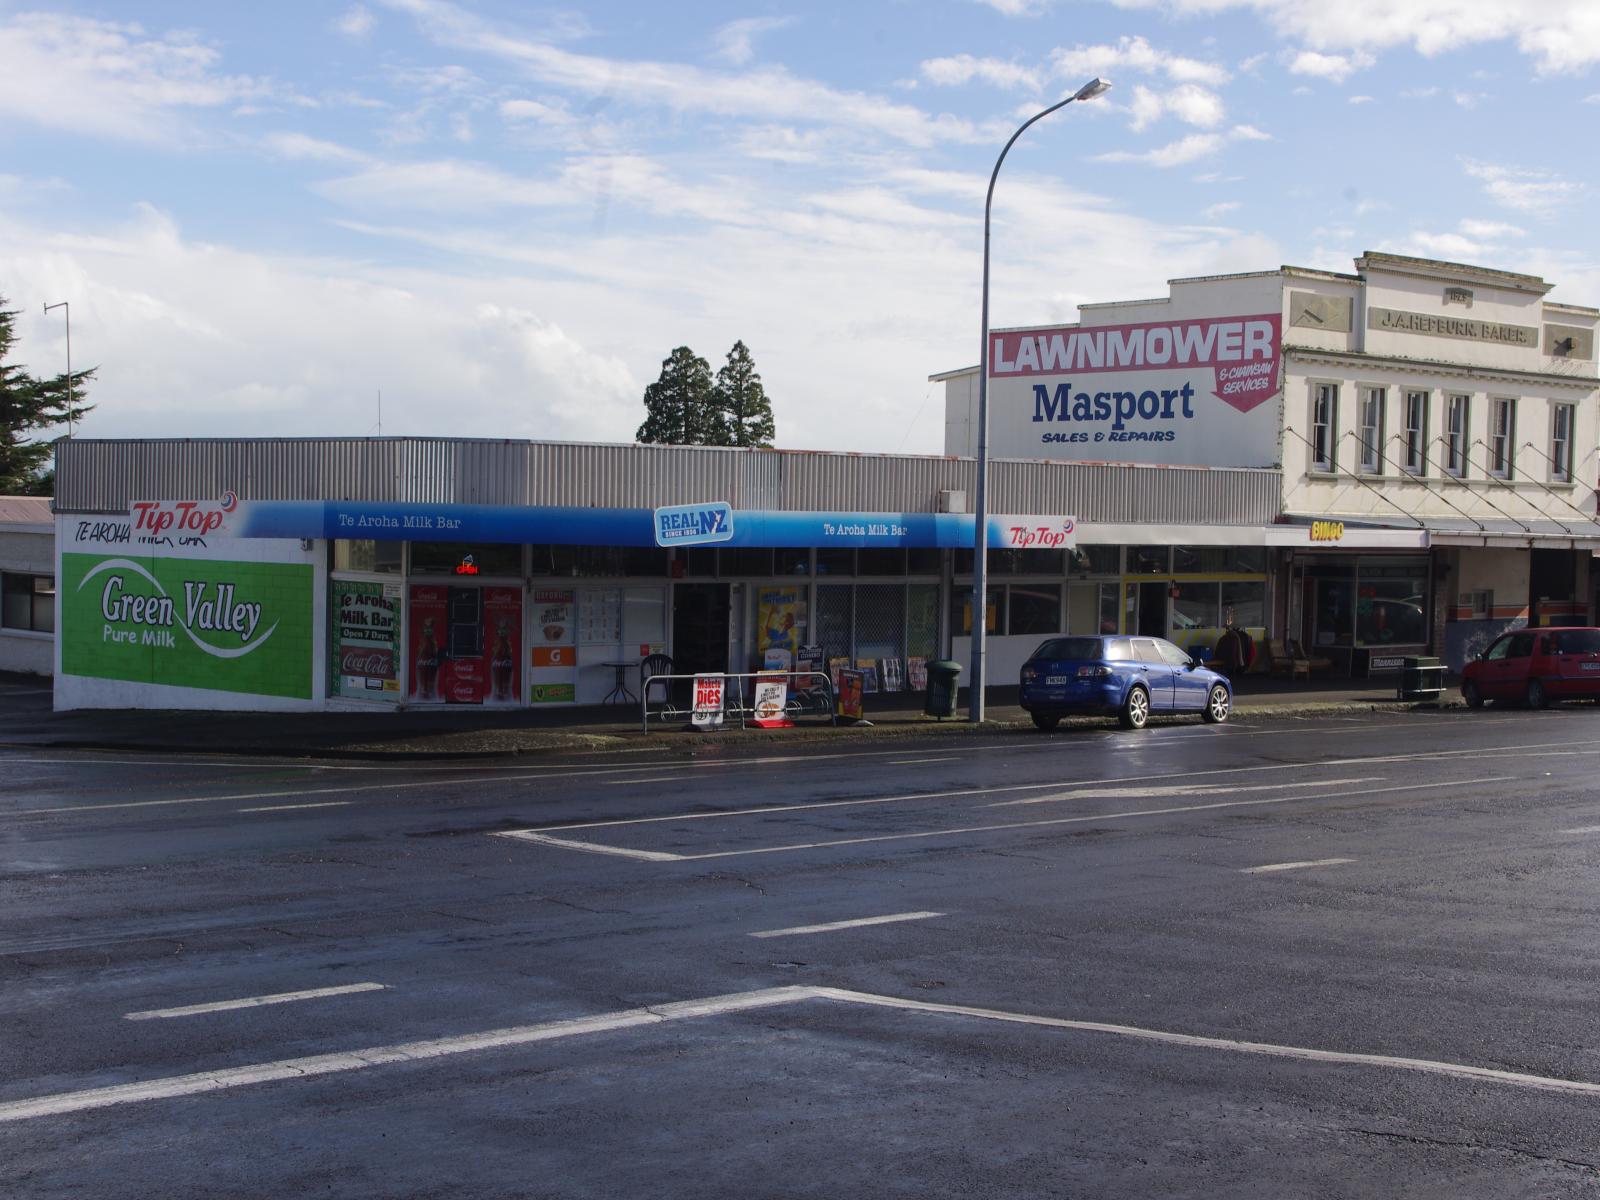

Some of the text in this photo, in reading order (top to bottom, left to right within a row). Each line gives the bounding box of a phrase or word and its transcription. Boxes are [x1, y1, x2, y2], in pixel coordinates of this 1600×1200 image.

[994, 320, 1273, 373] LAWNMOWER
[1219, 362, 1274, 381] & CHAINSAW
[1223, 379, 1269, 395] SERVICES
[1032, 381, 1194, 430] Masport
[1041, 430, 1175, 443] SALES & REPAIRS
[339, 513, 462, 529] Te Aroha Milk Bar
[660, 512, 699, 530] REAL
[824, 523, 908, 536] Te Aroha Milk Bar
[1309, 521, 1345, 541] BINGO
[102, 576, 261, 641] Green Valley
[355, 594, 393, 611] Aroha
[341, 610, 393, 627] Milk Bar
[103, 624, 175, 648] Pure Milk
[343, 628, 363, 640] Open
[364, 630, 370, 638] 7
[697, 689, 720, 708] pies
